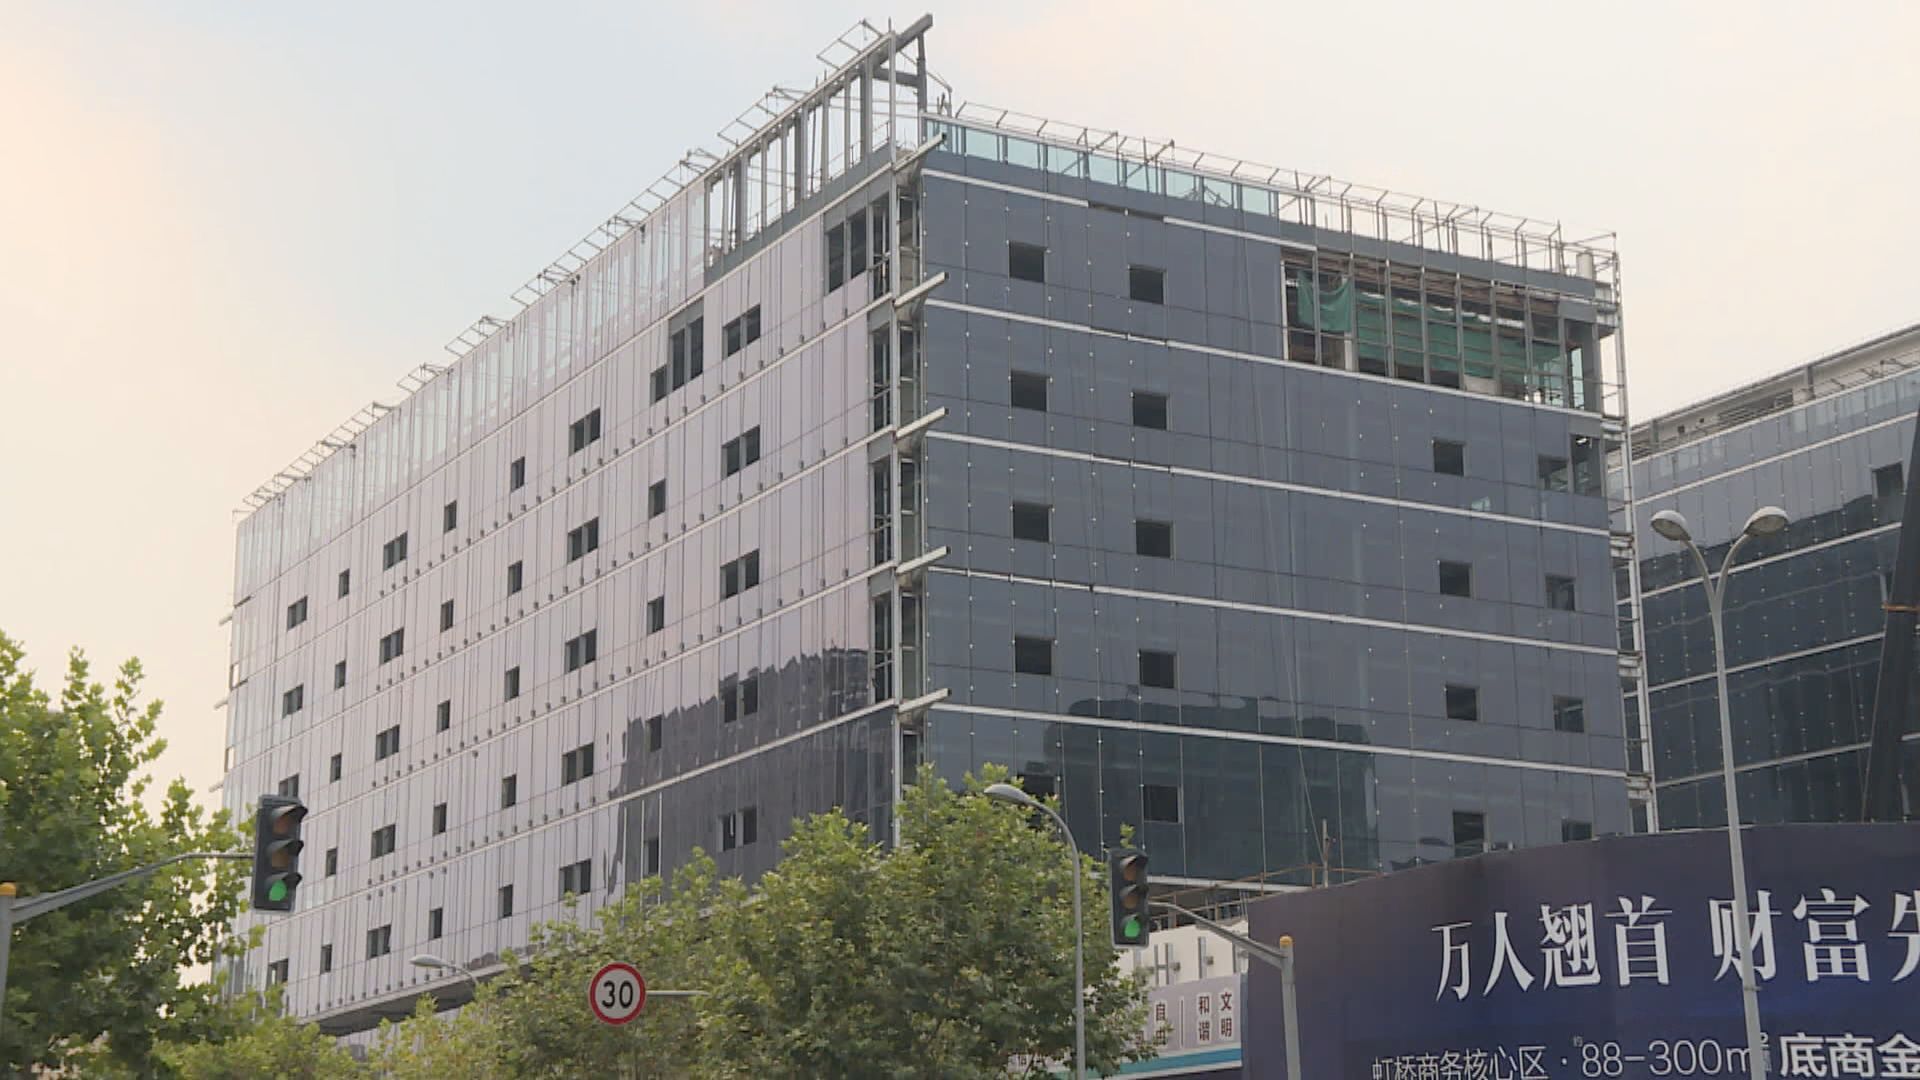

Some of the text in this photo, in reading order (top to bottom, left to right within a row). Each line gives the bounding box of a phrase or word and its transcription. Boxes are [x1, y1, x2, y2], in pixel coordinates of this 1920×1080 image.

[1431, 896, 1674, 1001] 万人翘首
[601, 981, 634, 1008] 30
[1198, 995, 1211, 1041] 和谐
[1220, 991, 1233, 1038] 文明
[1371, 1045, 1548, 1080] 虹桥商务核心区
[1779, 1031, 1920, 1079] 底商金
